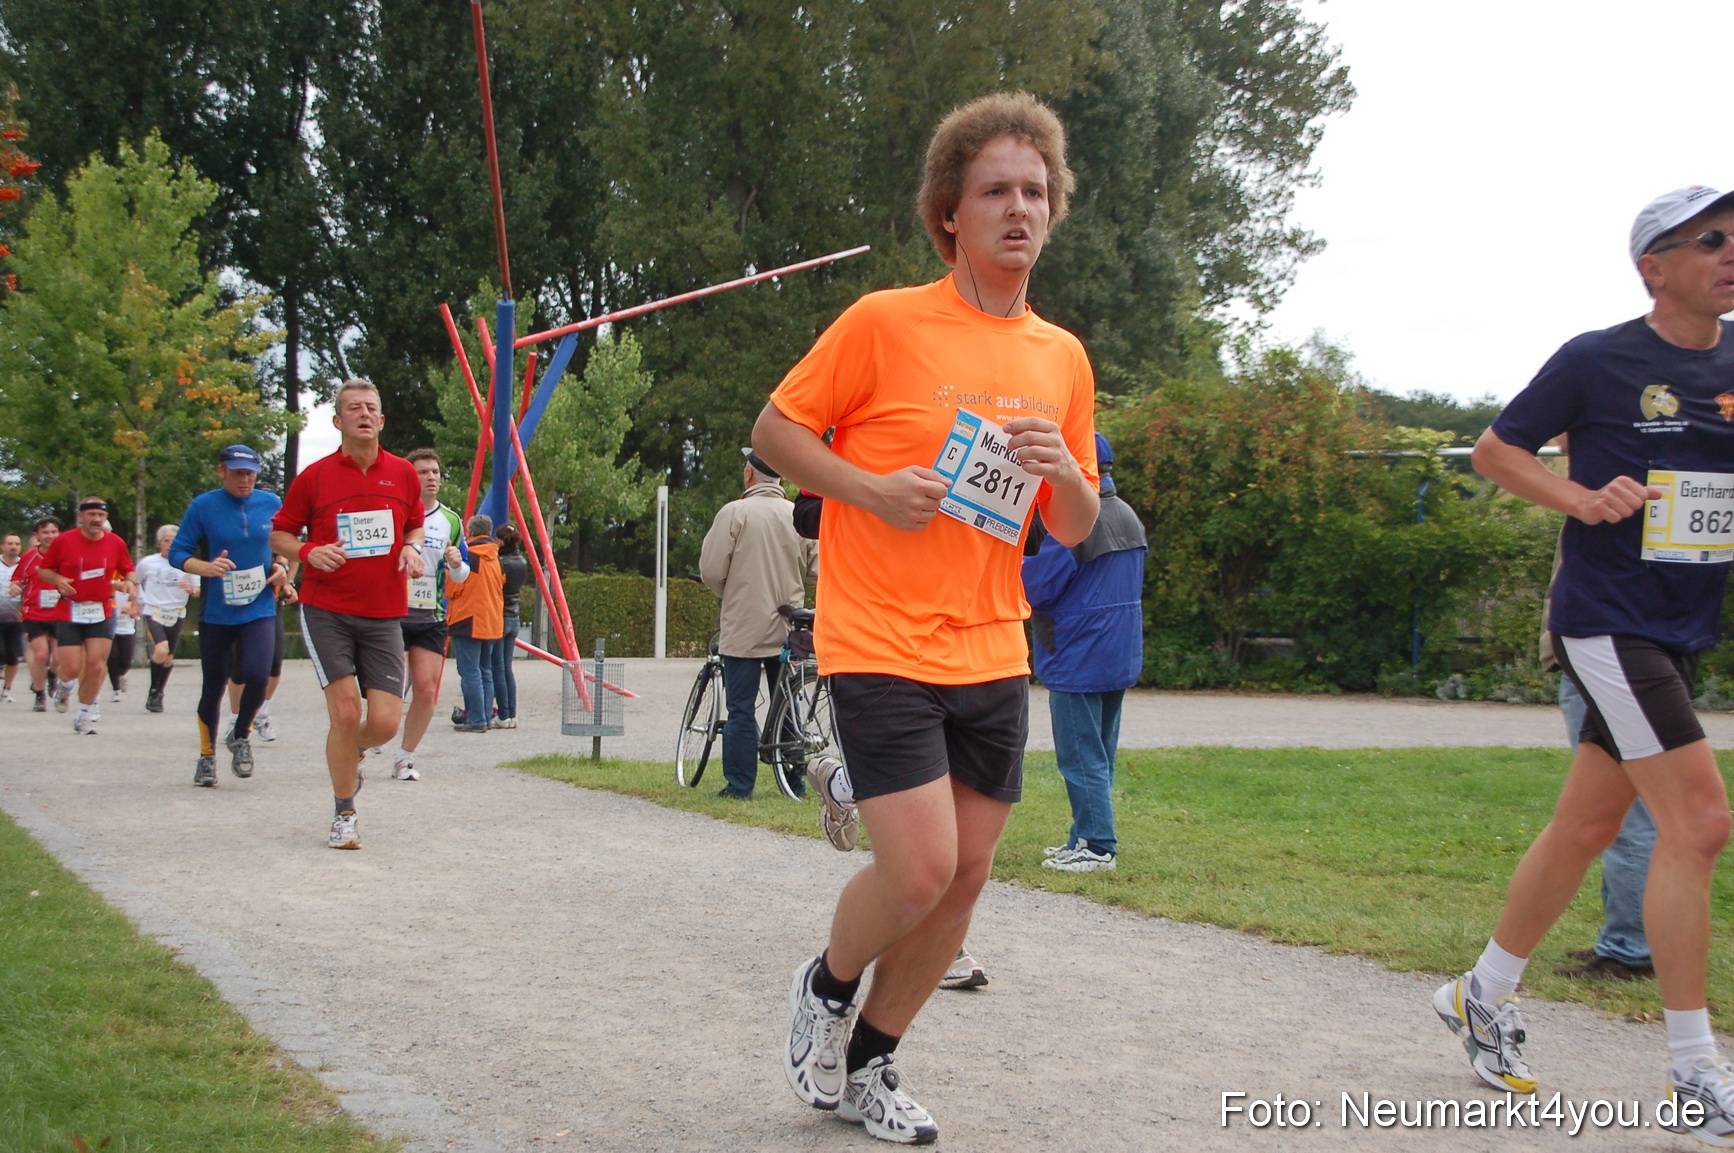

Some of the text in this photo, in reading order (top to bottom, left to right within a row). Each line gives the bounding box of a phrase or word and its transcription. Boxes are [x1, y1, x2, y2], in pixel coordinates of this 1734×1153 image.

[956, 390, 993, 406] stark
[947, 446, 958, 461] C
[966, 461, 1026, 506] 2811
[1649, 505, 1657, 518] C
[353, 517, 375, 526] Dieter
[985, 517, 1019, 540] PFLEIDERER
[355, 527, 389, 542] 3342
[237, 580, 262, 593] 3427
[414, 589, 432, 599] 416
